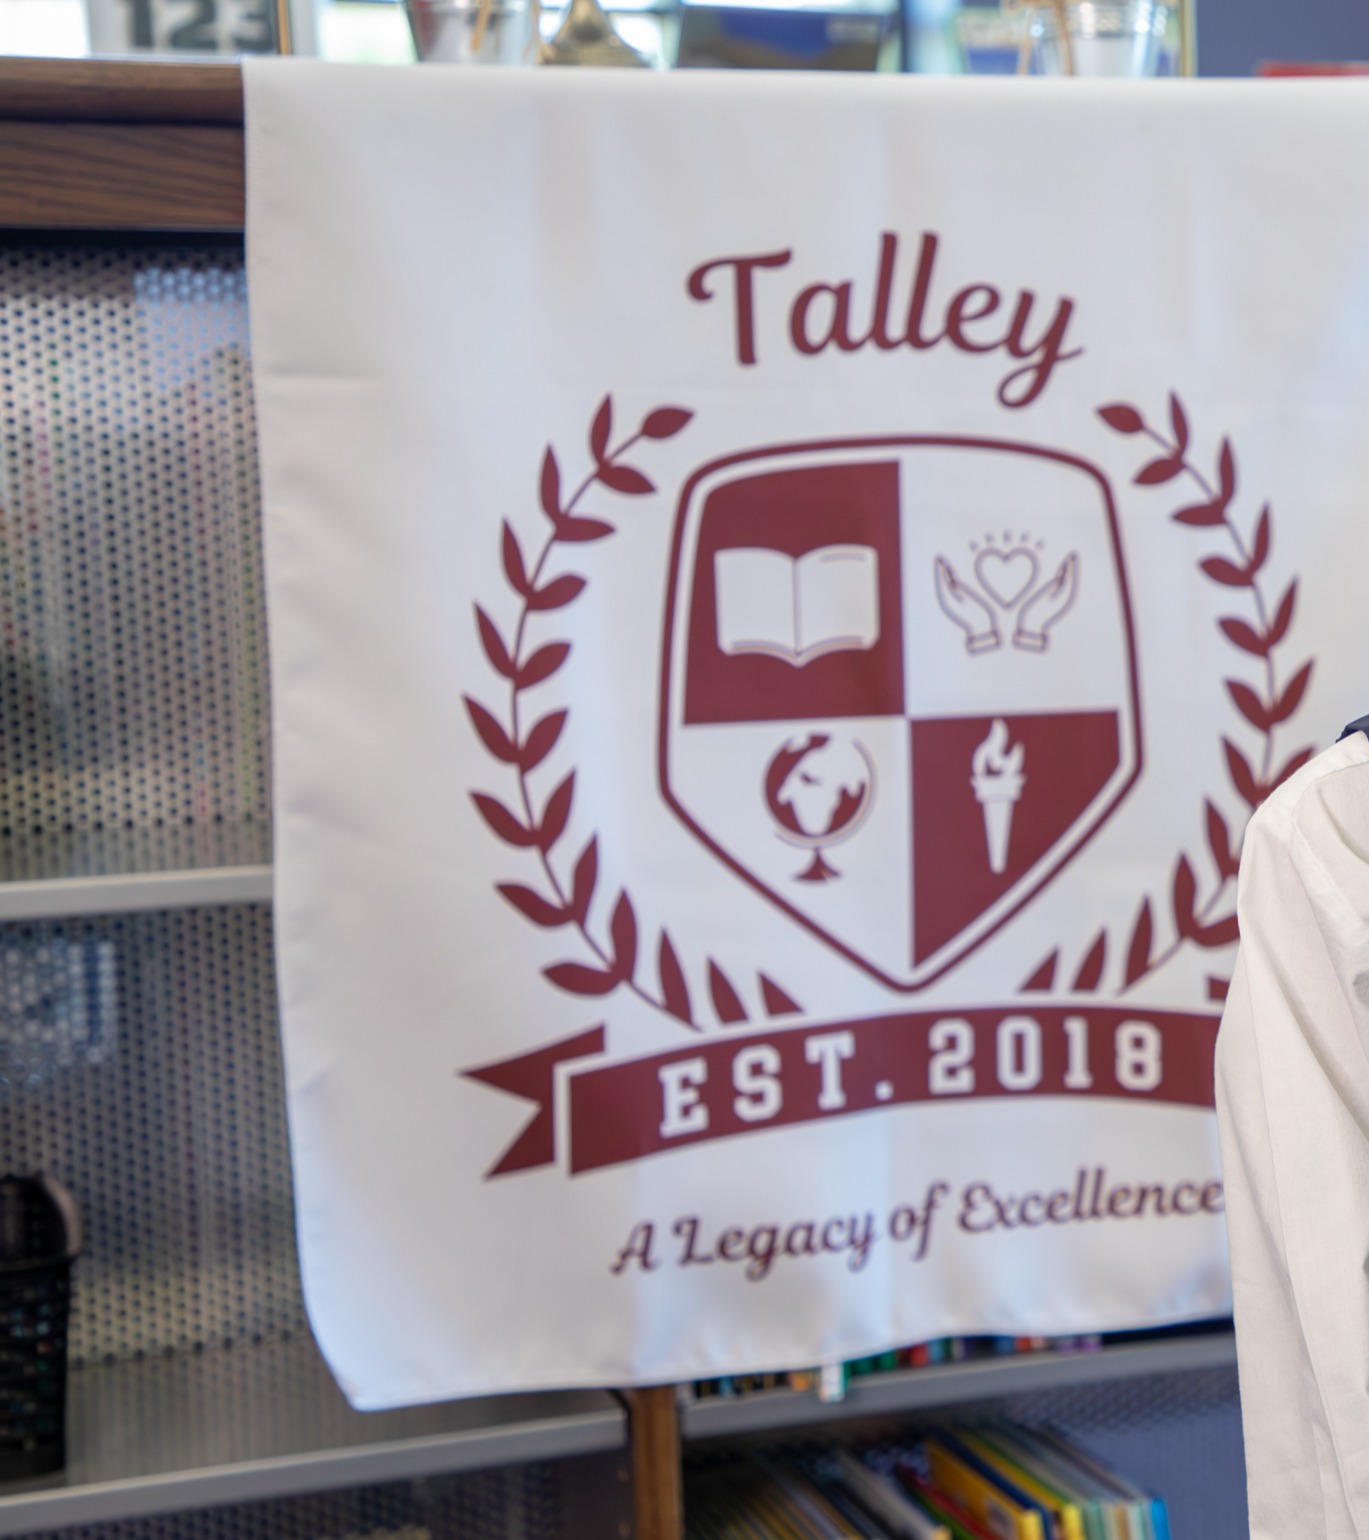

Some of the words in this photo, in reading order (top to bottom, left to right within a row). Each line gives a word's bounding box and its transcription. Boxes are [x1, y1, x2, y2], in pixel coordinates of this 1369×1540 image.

[686, 230, 1085, 410] Talley
[658, 1030, 895, 1139] EST.
[927, 1014, 1164, 1096] 2018
[609, 1220, 659, 1276] A
[673, 1209, 875, 1283] Legacy
[887, 1178, 950, 1263] of
[955, 1163, 1226, 1235] Excellence
